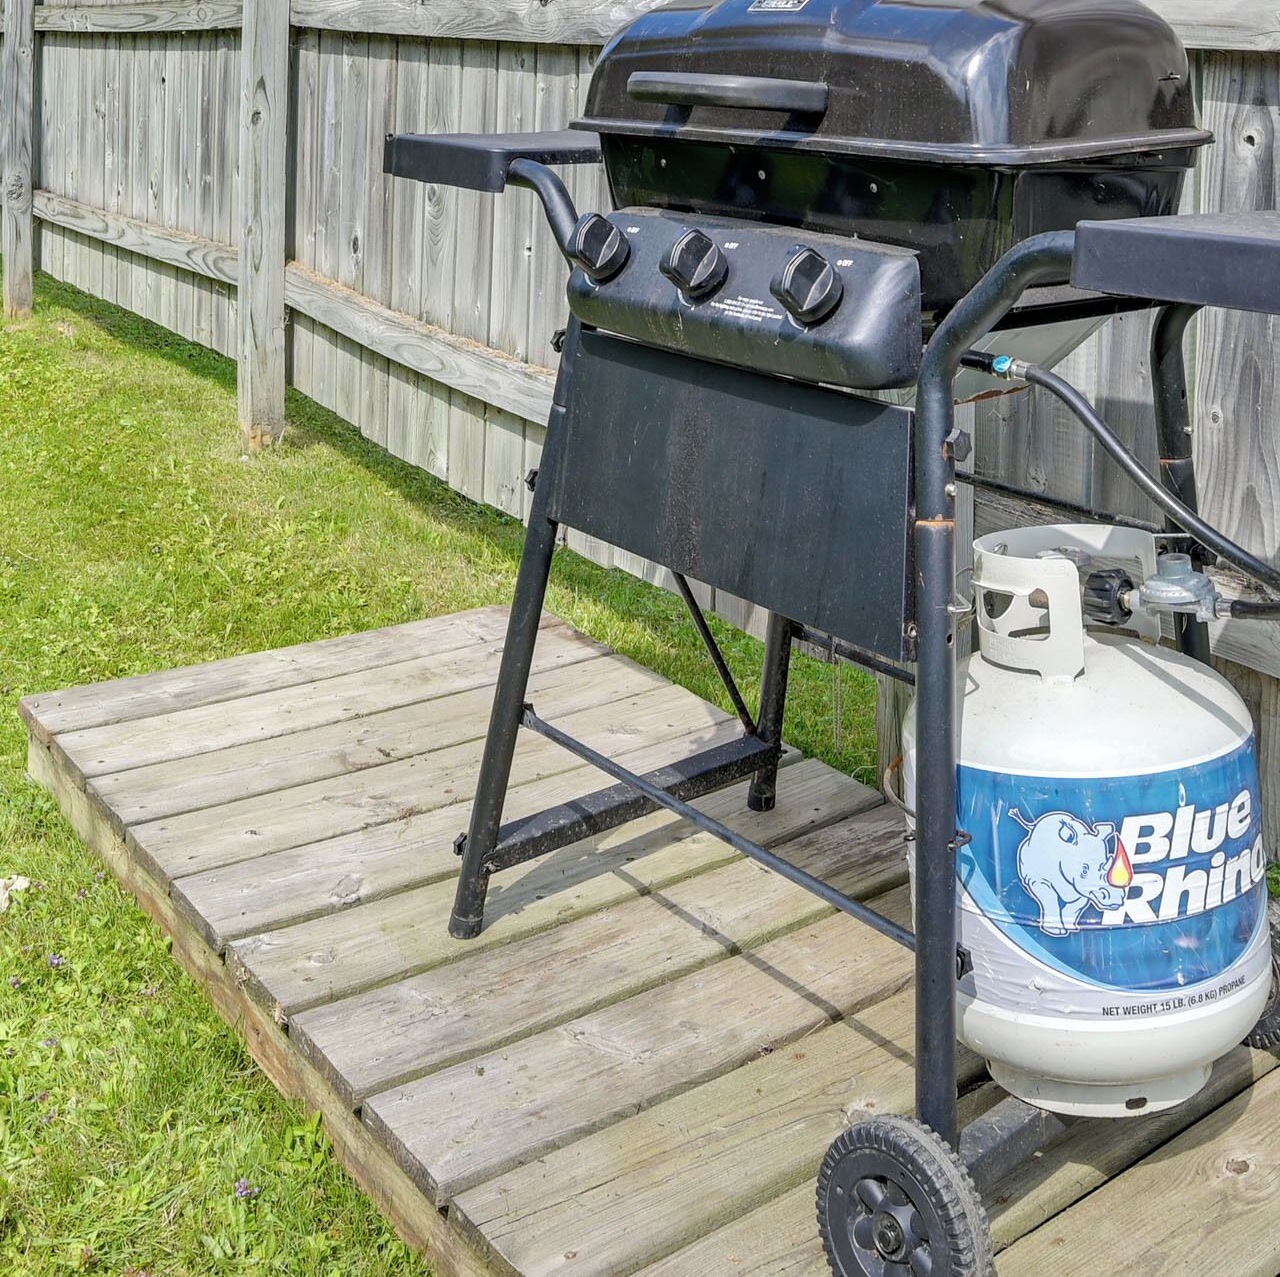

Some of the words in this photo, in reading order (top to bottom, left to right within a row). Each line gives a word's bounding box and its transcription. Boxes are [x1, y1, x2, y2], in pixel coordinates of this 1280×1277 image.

[1120, 789, 1251, 864] Blue
[1101, 832, 1265, 926] Rhino
[1102, 1006, 1120, 1017] NET
[1122, 1003, 1158, 1015] WEIGHT
[1160, 1001, 1171, 1012] 15
[1172, 998, 1186, 1009] LB.
[1188, 993, 1203, 1008] (6.8
[1204, 988, 1218, 1001] KG)
[1218, 974, 1246, 997] PROPANE
